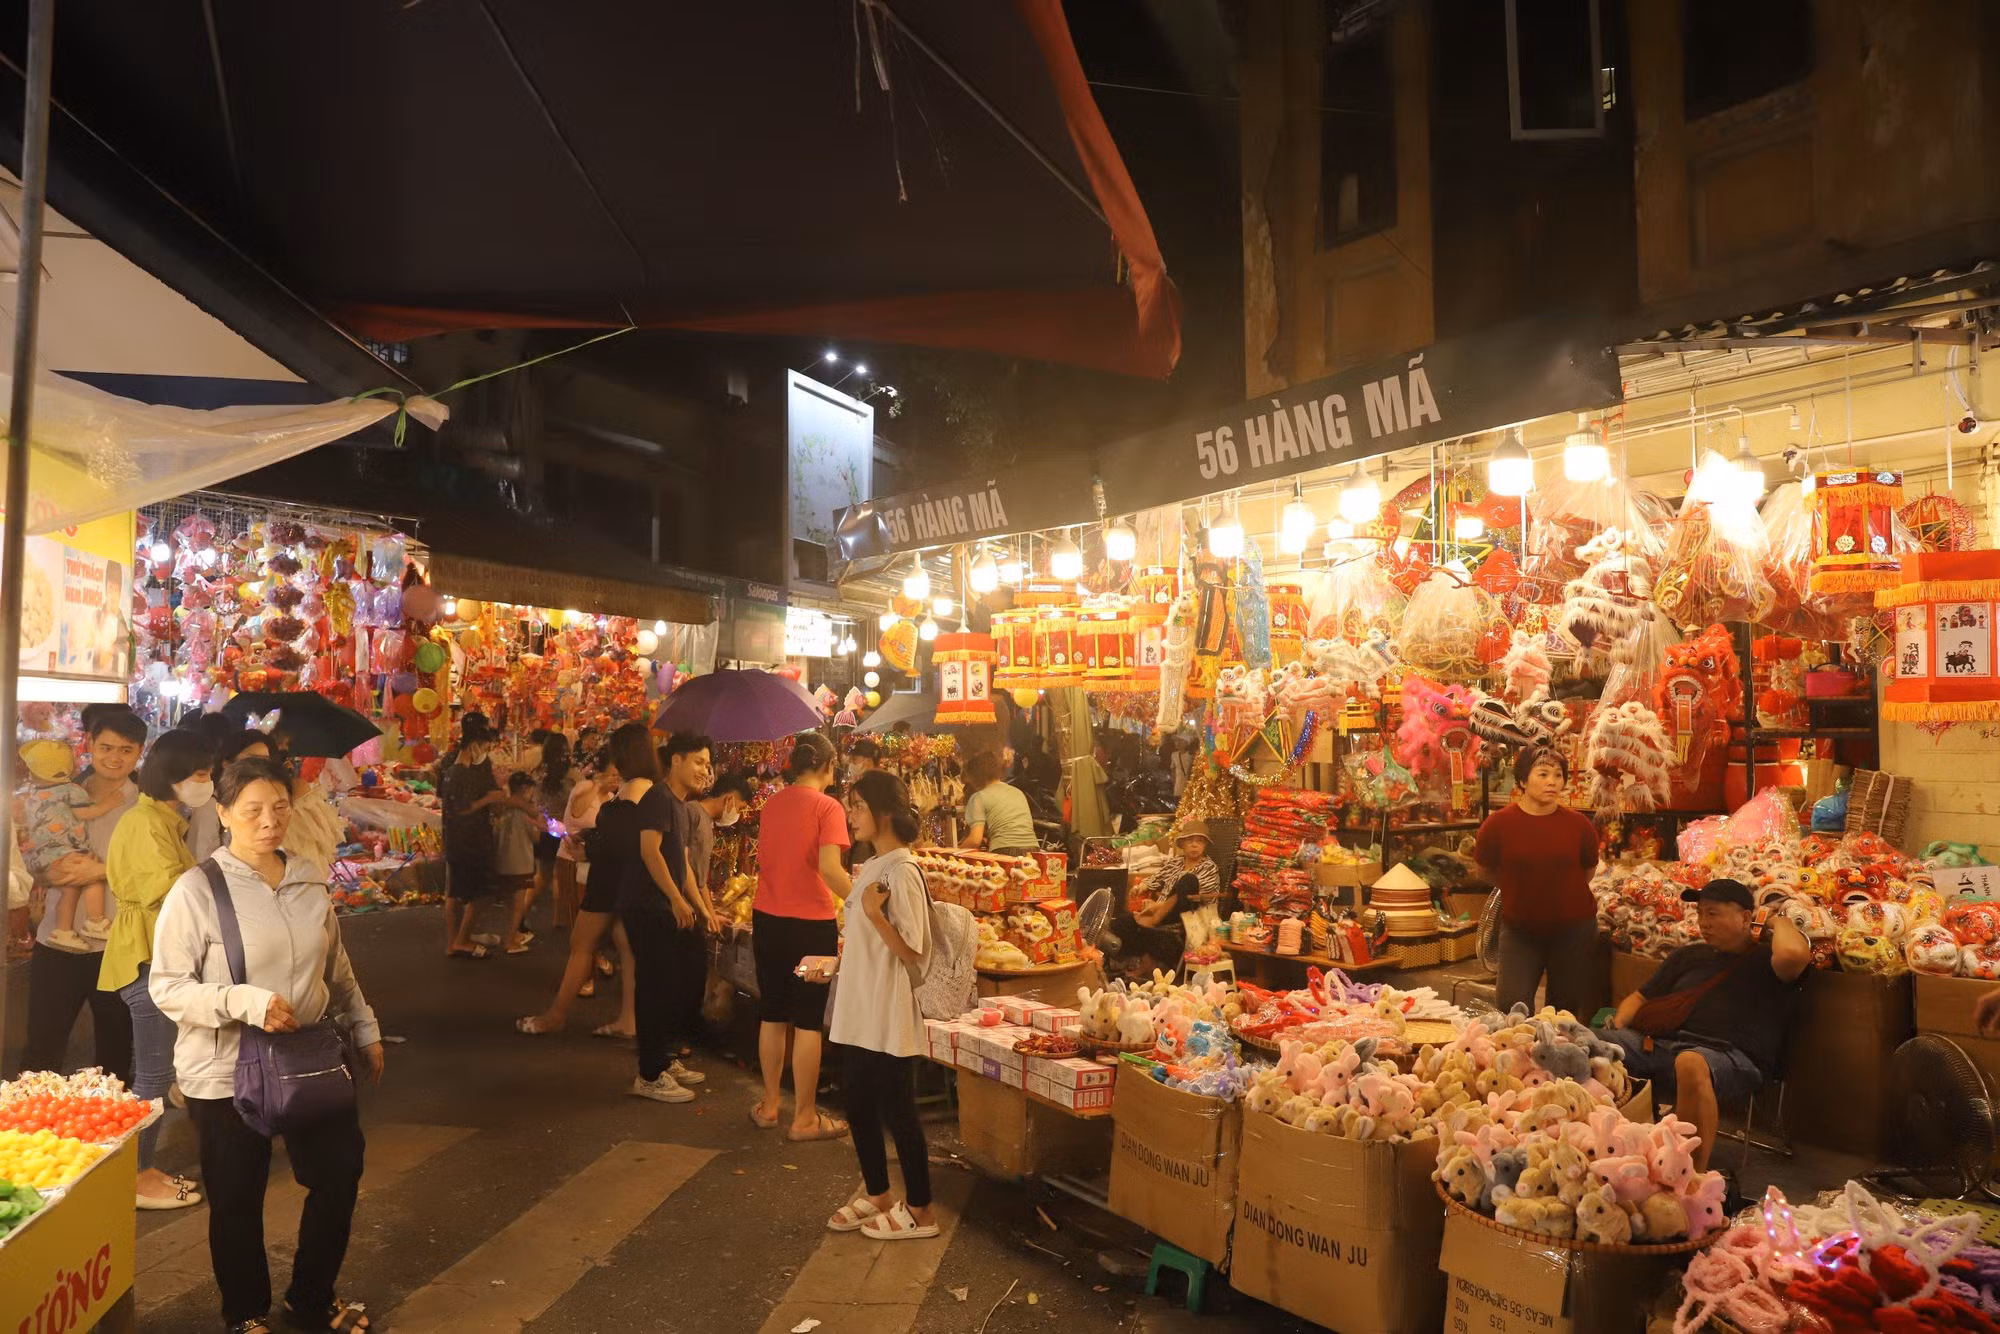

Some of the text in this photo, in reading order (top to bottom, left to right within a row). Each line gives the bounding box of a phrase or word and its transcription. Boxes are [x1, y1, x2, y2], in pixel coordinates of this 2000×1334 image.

[1195, 352, 1442, 480] 56 HÀNG MÃ
[884, 479, 1009, 544] 56 HÀNG MÃ
[747, 583, 779, 602] Salonpas
[1121, 1131, 1210, 1187] DIAN DONG WAN JU
[1243, 1200, 1367, 1267] DIAN DONG WAN JU
[1455, 1297, 1507, 1333] 13.5 KGS
